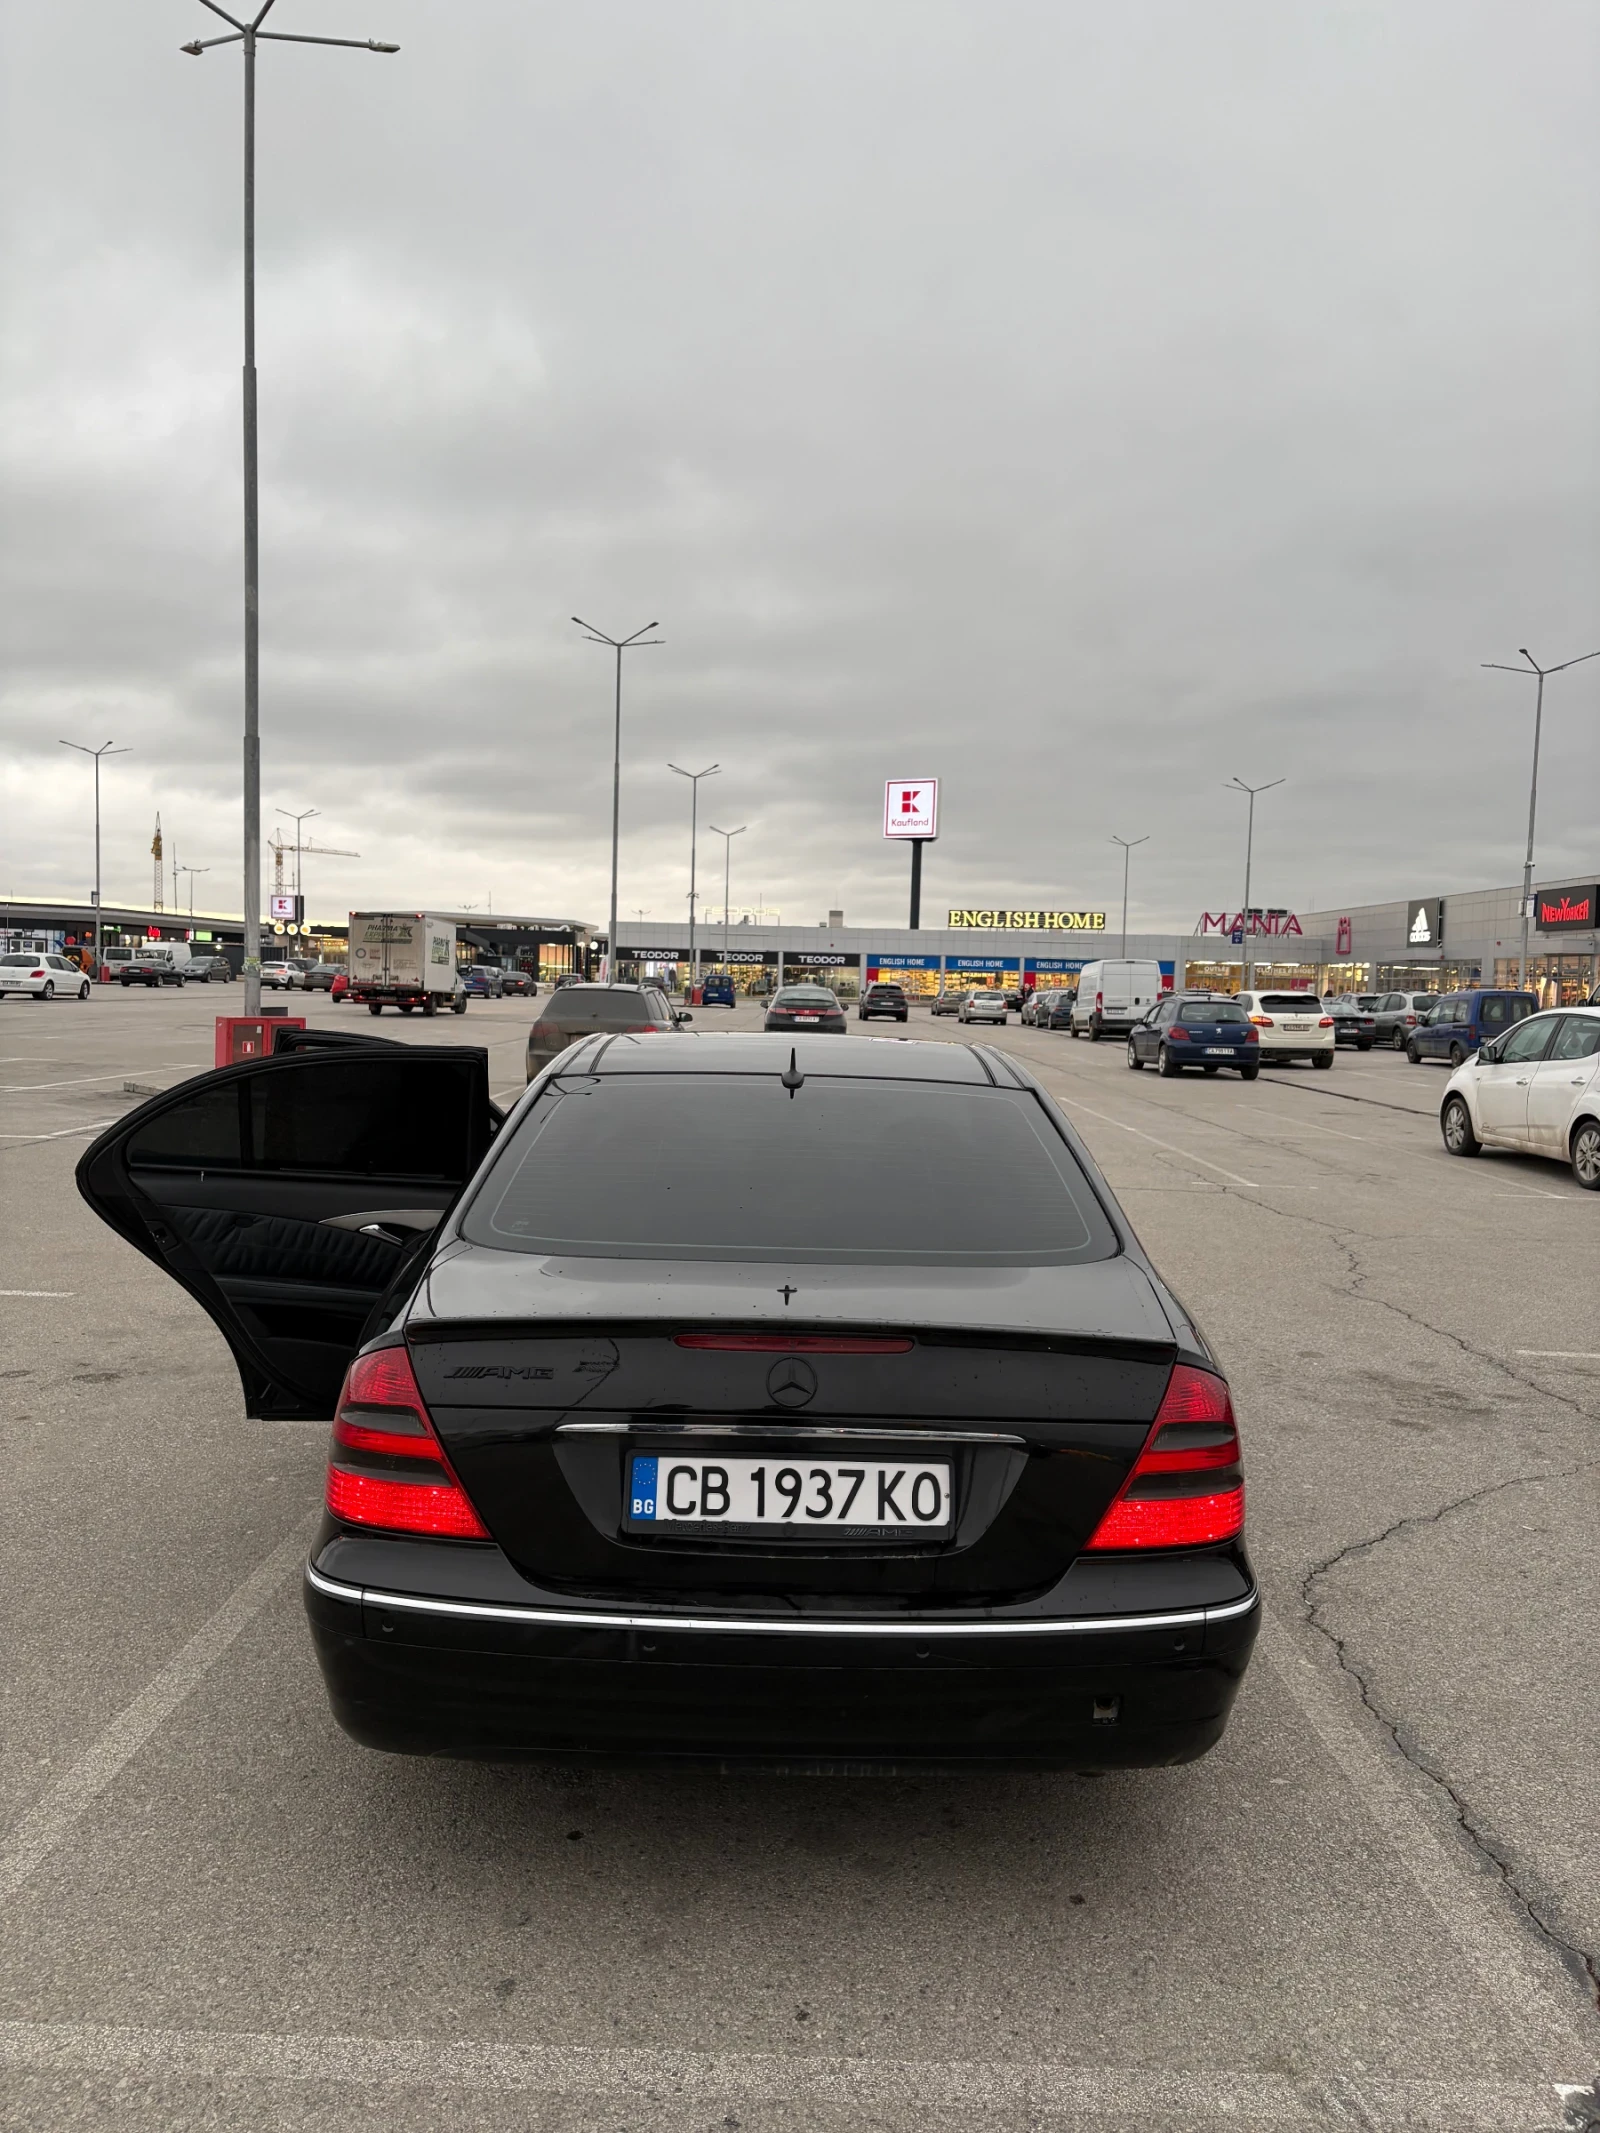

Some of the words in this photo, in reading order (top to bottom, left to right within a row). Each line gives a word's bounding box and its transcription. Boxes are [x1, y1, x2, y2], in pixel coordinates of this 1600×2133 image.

[891, 818, 929, 827] Kaufland
[949, 910, 1040, 928] ENGLISH
[1044, 912, 1104, 929] HOME
[1203, 912, 1303, 935] MANIA
[632, 951, 680, 960] TEODOR
[716, 953, 764, 962] TEODOR
[798, 955, 846, 965] TEODOR
[879, 958, 906, 966] ENGLISH
[907, 959, 926, 967] HOME
[957, 959, 984, 967] ENGLISH
[985, 960, 1004, 968] HOME
[1036, 961, 1062, 969] ENGLISH
[1065, 962, 1083, 970] HOME
[666, 1465, 731, 1518] CB
[750, 1466, 866, 1520] 1937
[877, 1470, 942, 1522] KO
[632, 1499, 654, 1515] BG
[664, 1519, 750, 1535] Mercedes-Benz
